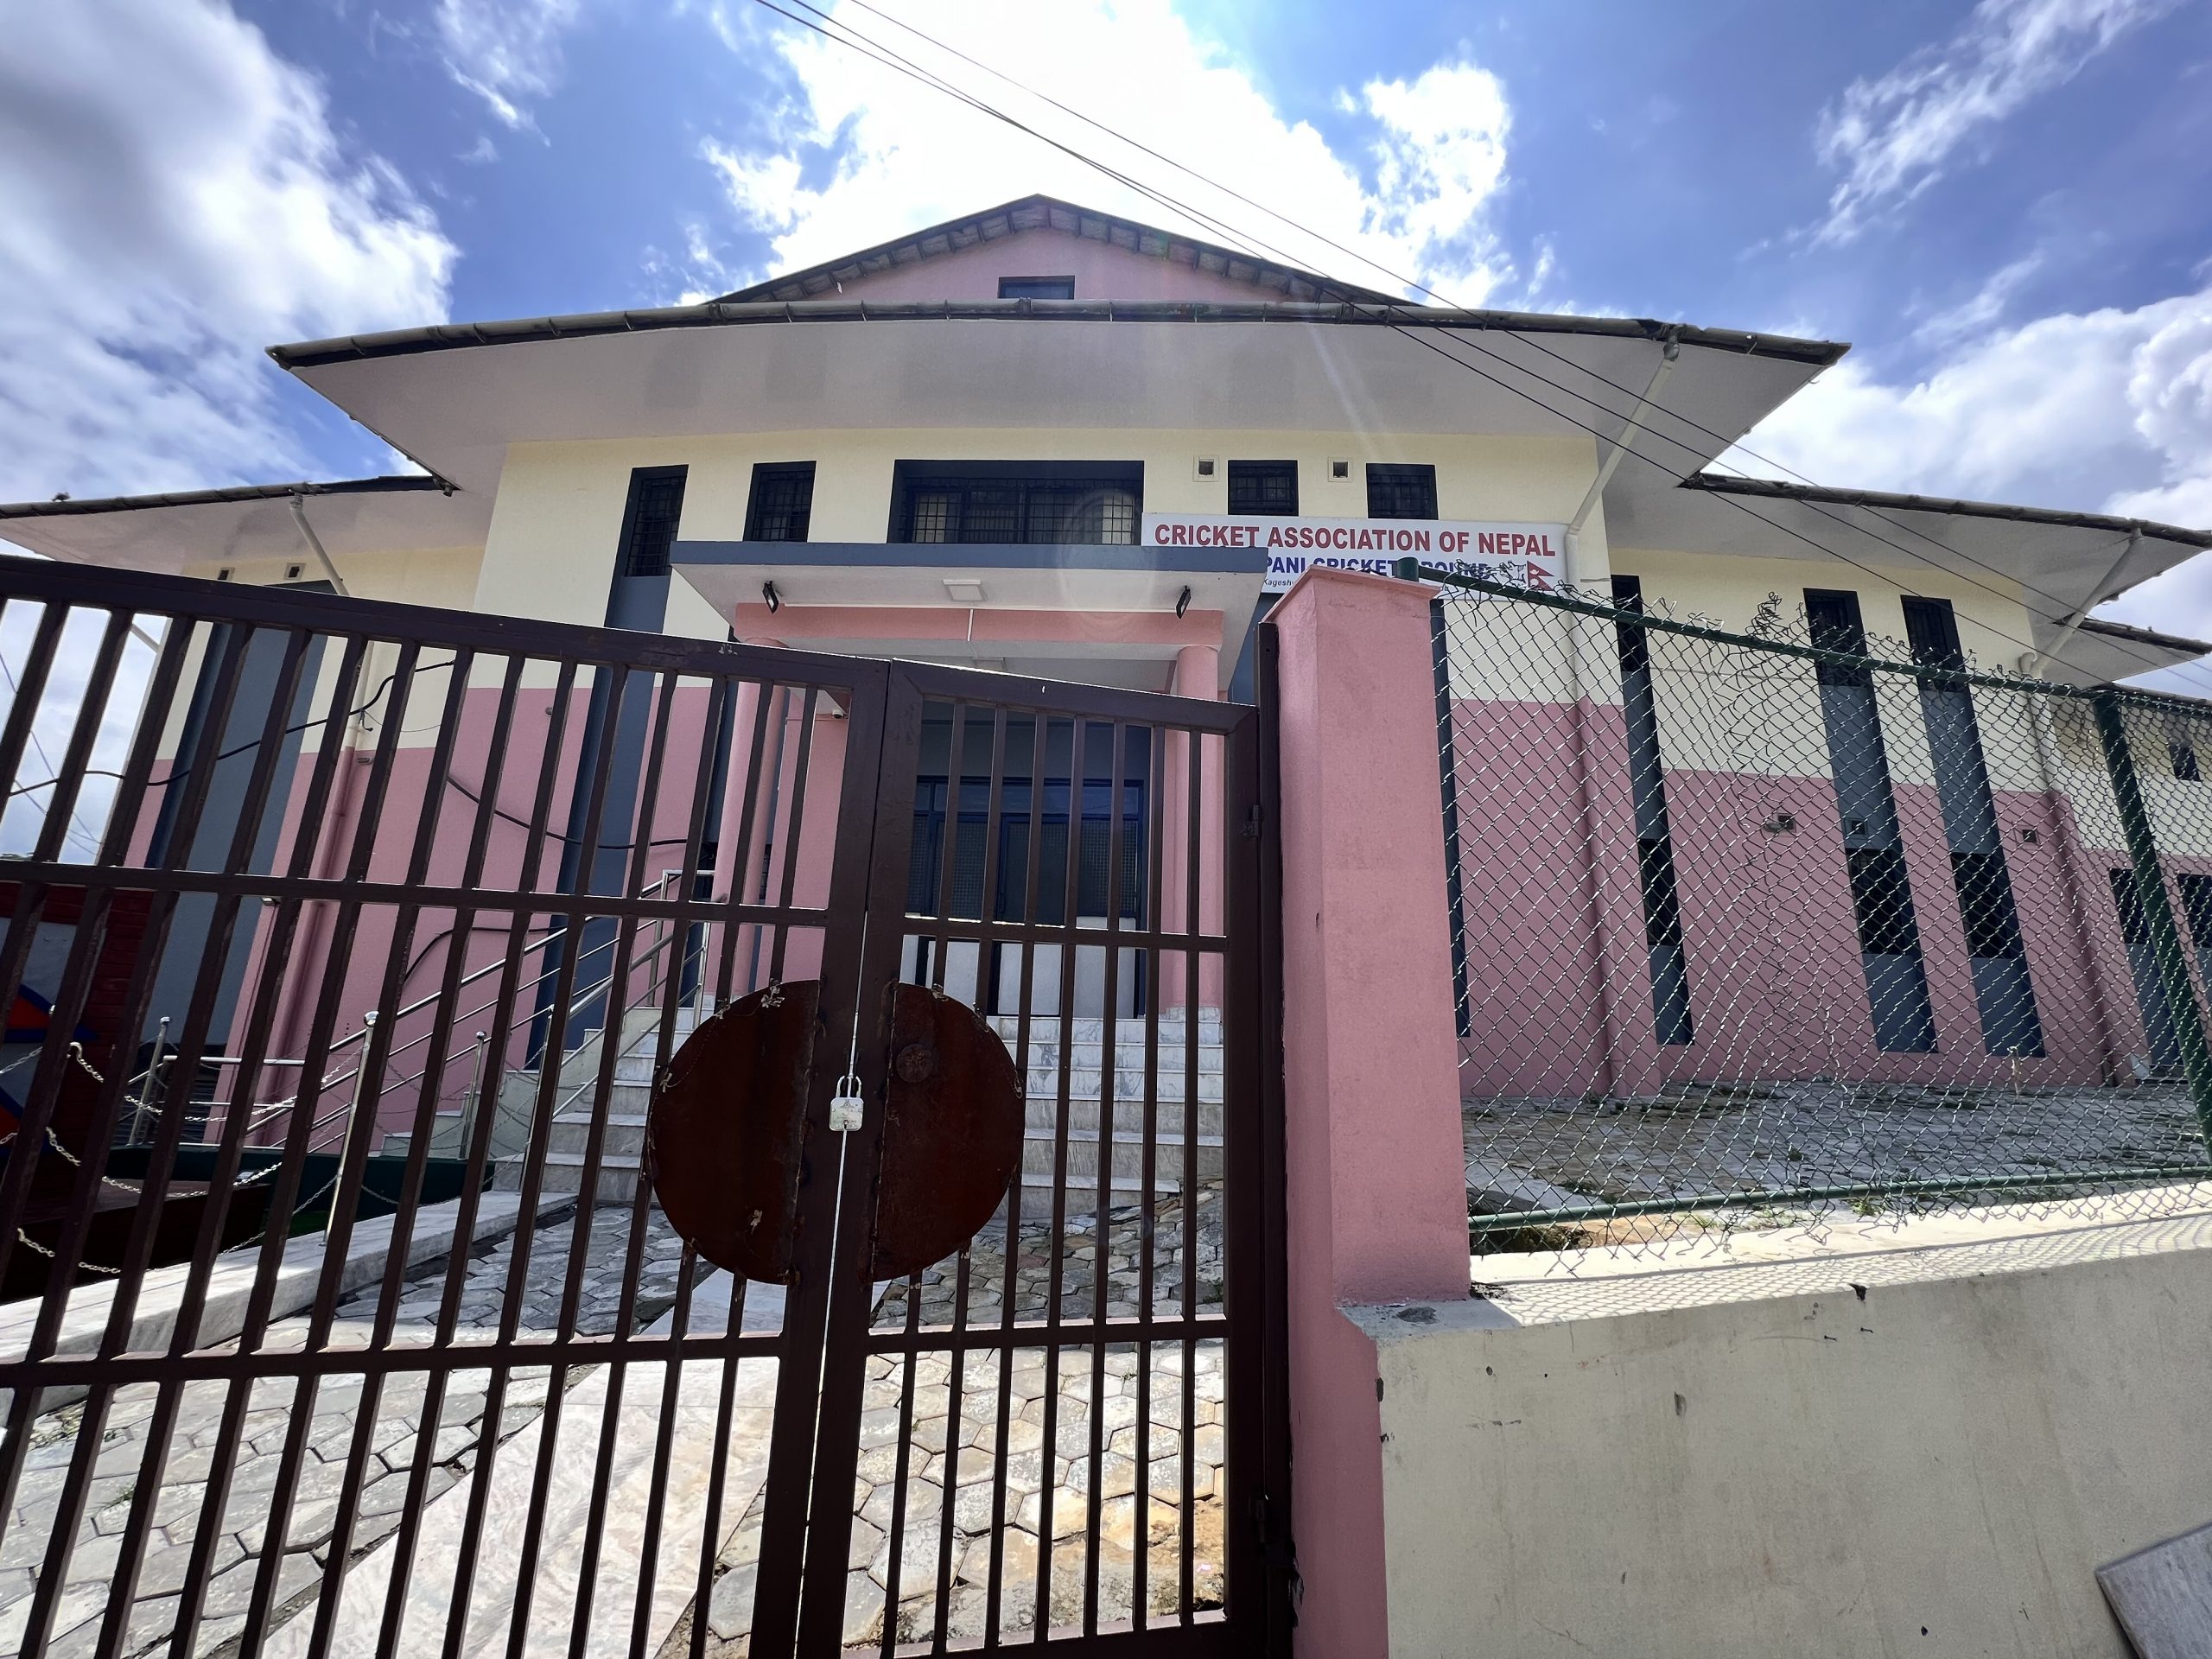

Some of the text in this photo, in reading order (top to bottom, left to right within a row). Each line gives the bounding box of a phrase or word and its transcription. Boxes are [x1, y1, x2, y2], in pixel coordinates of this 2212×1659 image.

[1154, 524, 1556, 556] CRICKET ASSOCIATION OF NEPAL
